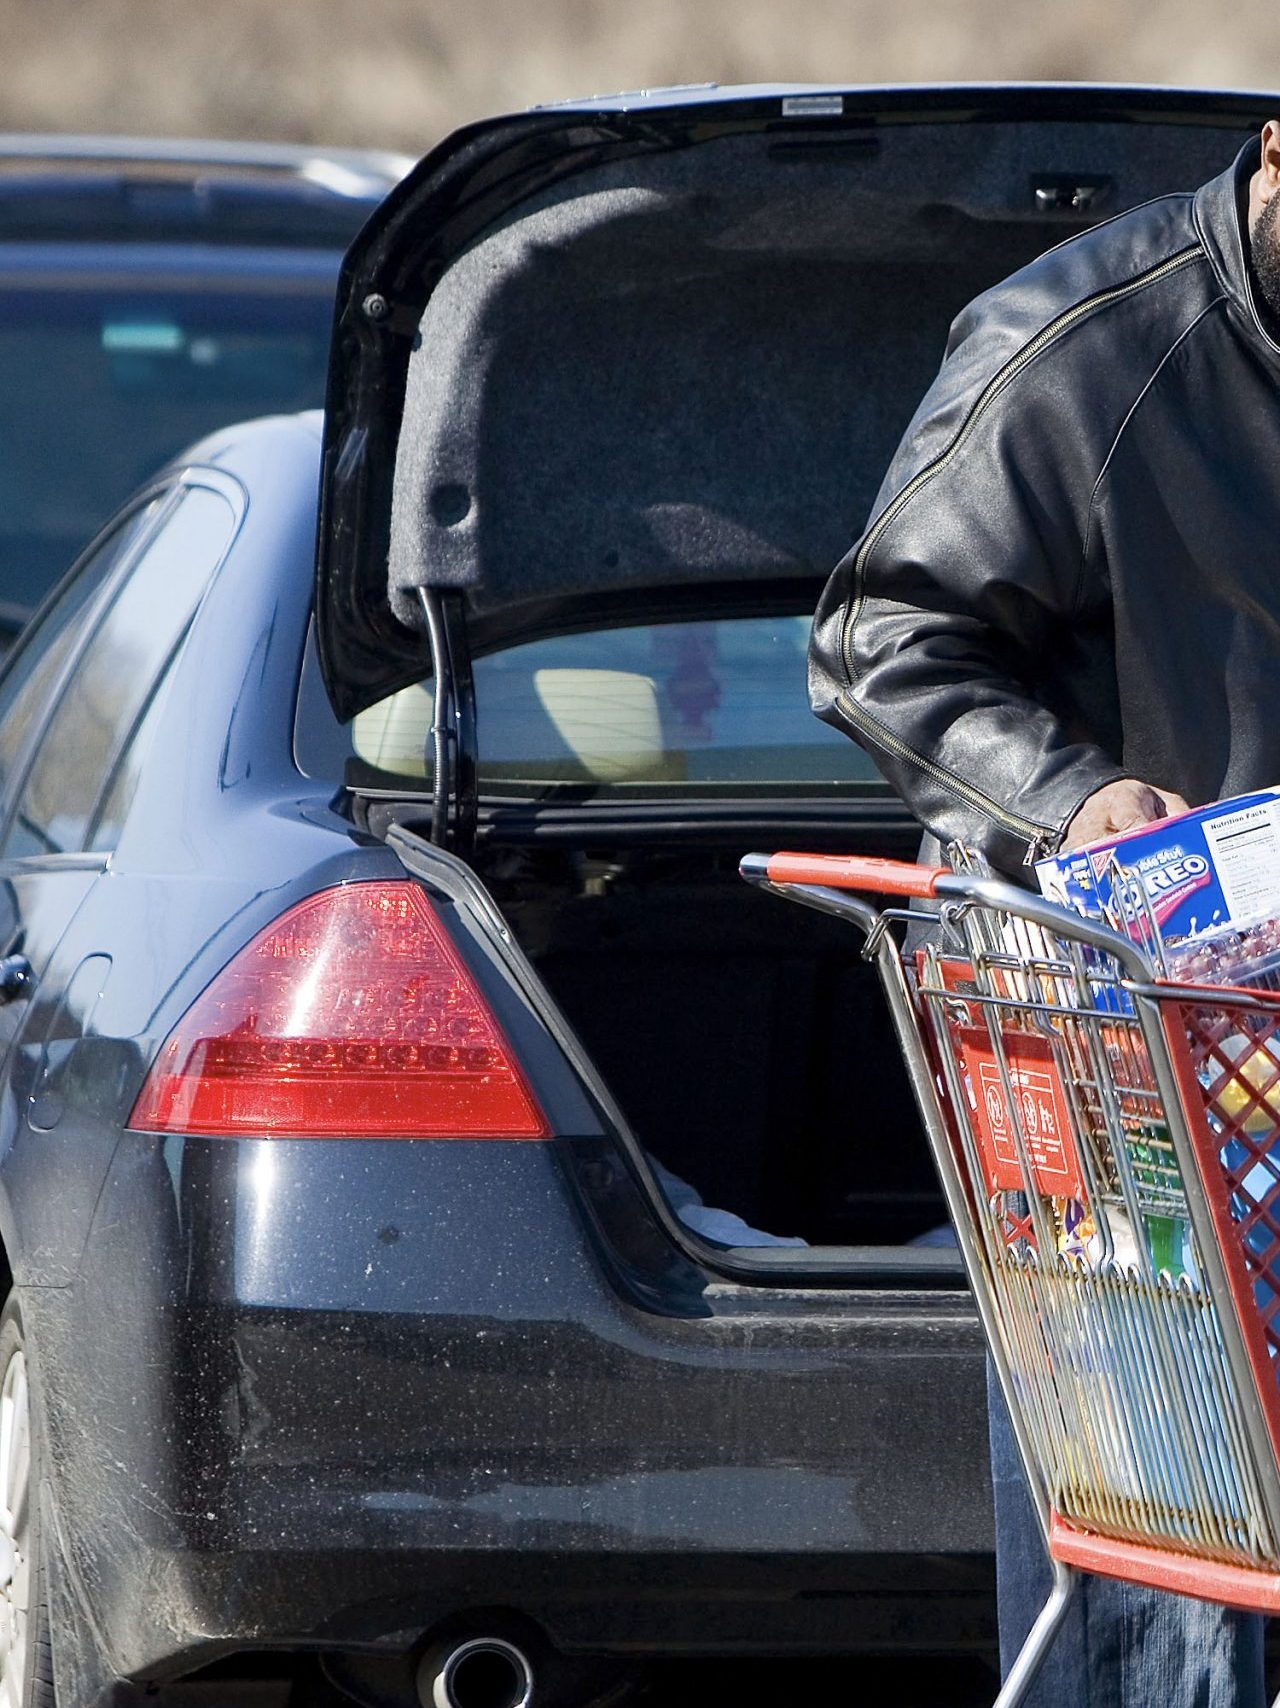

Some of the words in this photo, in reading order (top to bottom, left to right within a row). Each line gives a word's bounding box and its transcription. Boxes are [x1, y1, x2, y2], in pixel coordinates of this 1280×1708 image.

[1210, 816, 1245, 830] Nutrition
[1246, 809, 1267, 819] Facts
[1109, 855, 1208, 914] OREO
